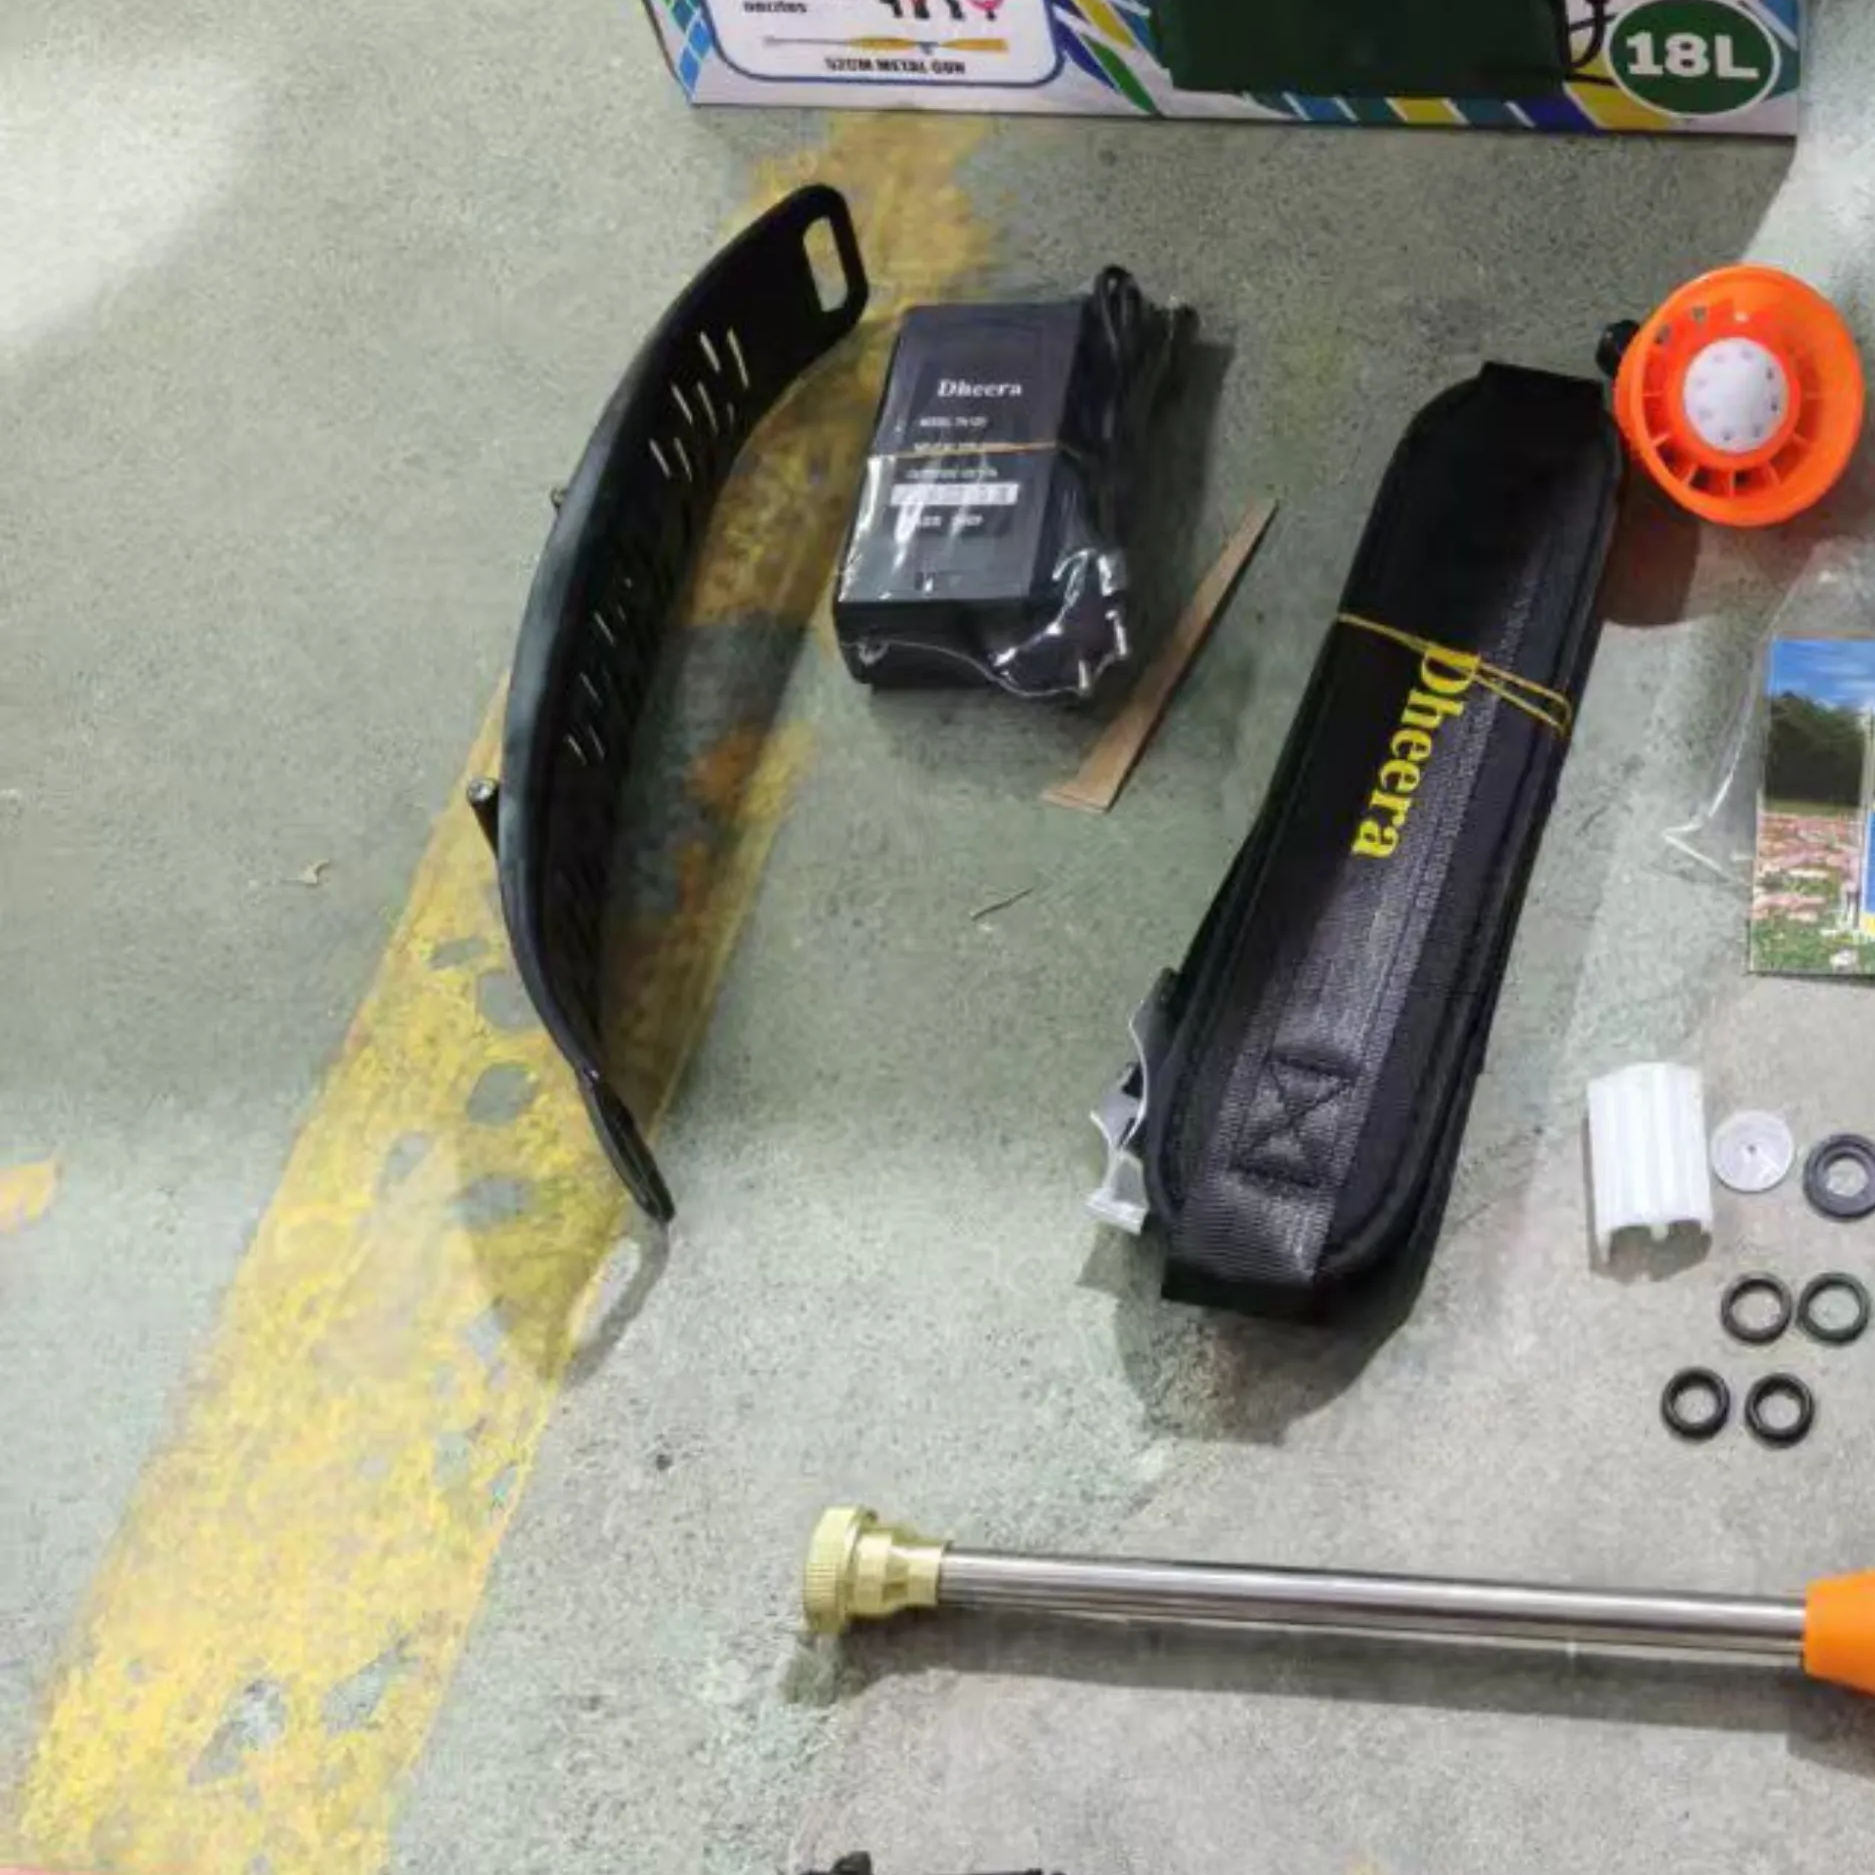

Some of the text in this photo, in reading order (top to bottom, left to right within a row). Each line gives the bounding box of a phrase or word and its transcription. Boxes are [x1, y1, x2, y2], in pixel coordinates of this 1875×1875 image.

[1625, 28, 1760, 81] 18L
[937, 379, 1022, 397] Dheera
[1351, 648, 1481, 858] Dheera
